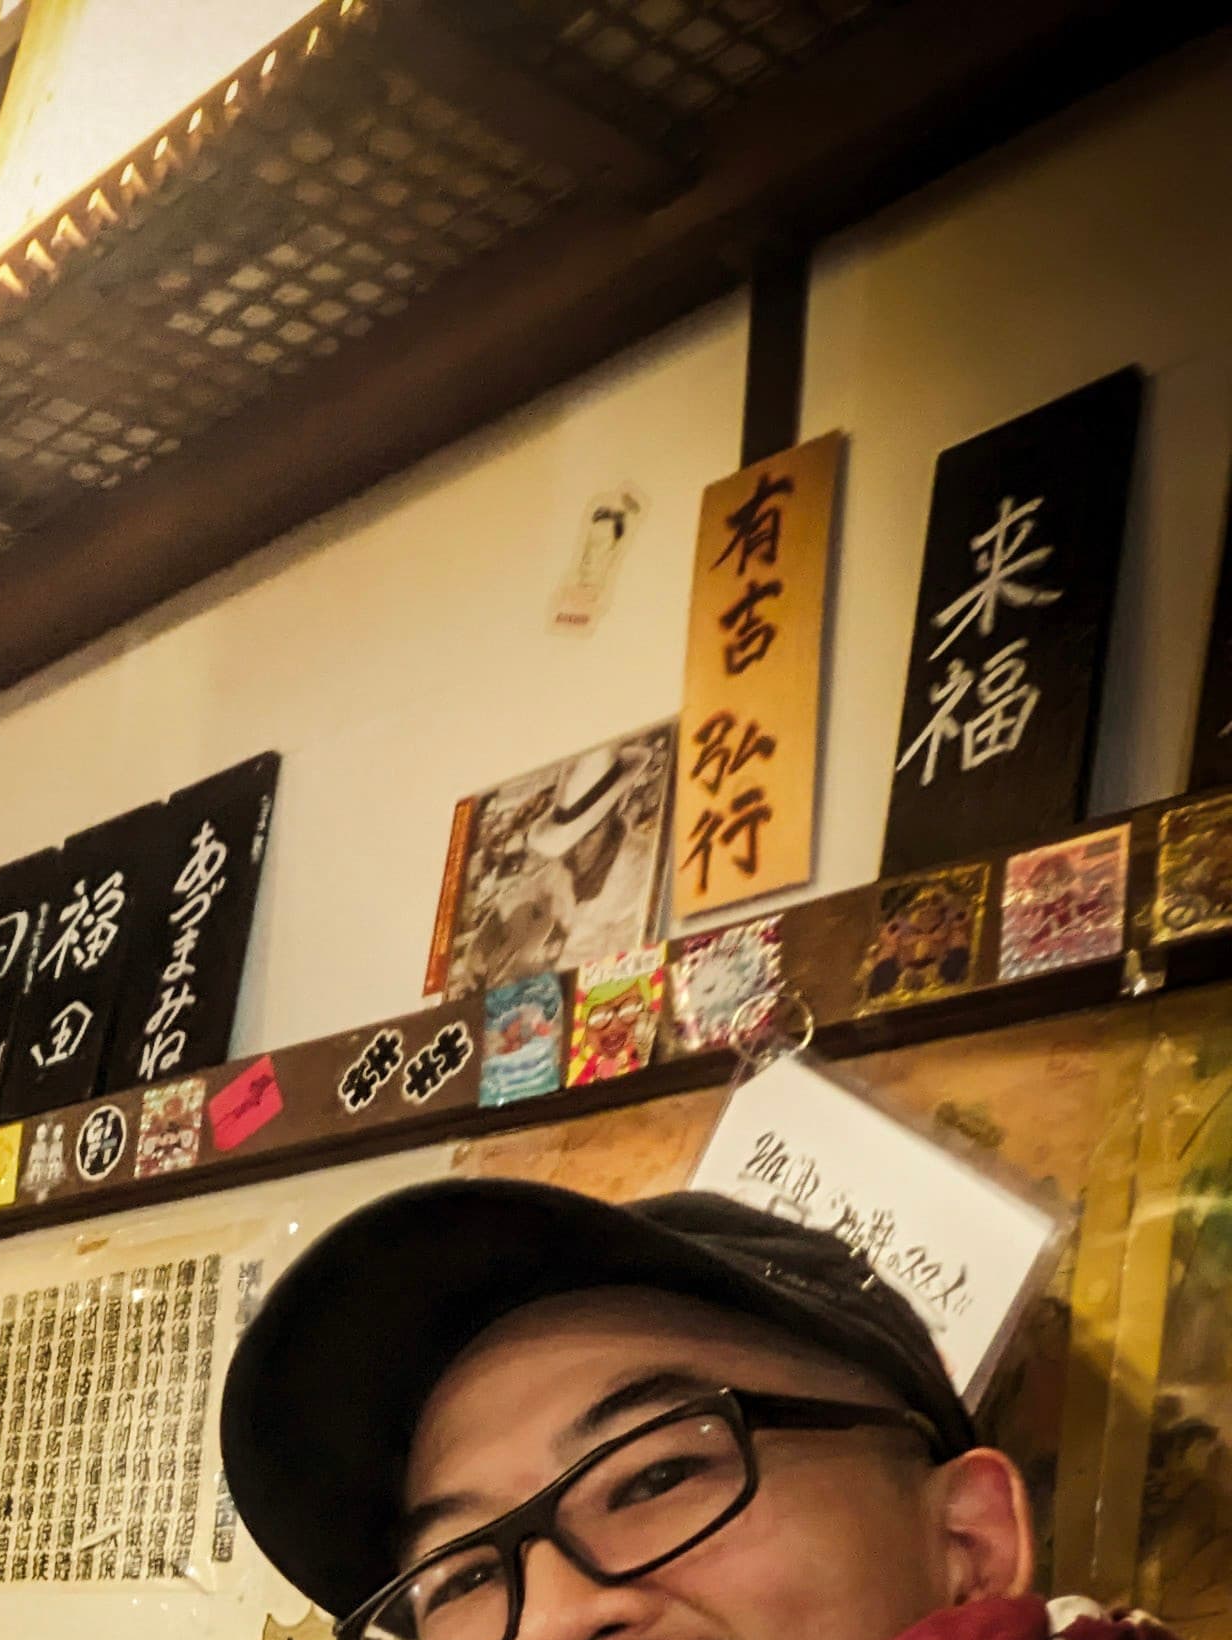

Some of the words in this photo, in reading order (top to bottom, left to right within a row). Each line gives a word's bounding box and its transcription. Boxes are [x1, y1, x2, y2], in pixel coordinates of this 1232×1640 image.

[679, 469, 795, 896] 有吉弘行
[895, 495, 1064, 788] 来福
[30, 871, 126, 1067] 福田
